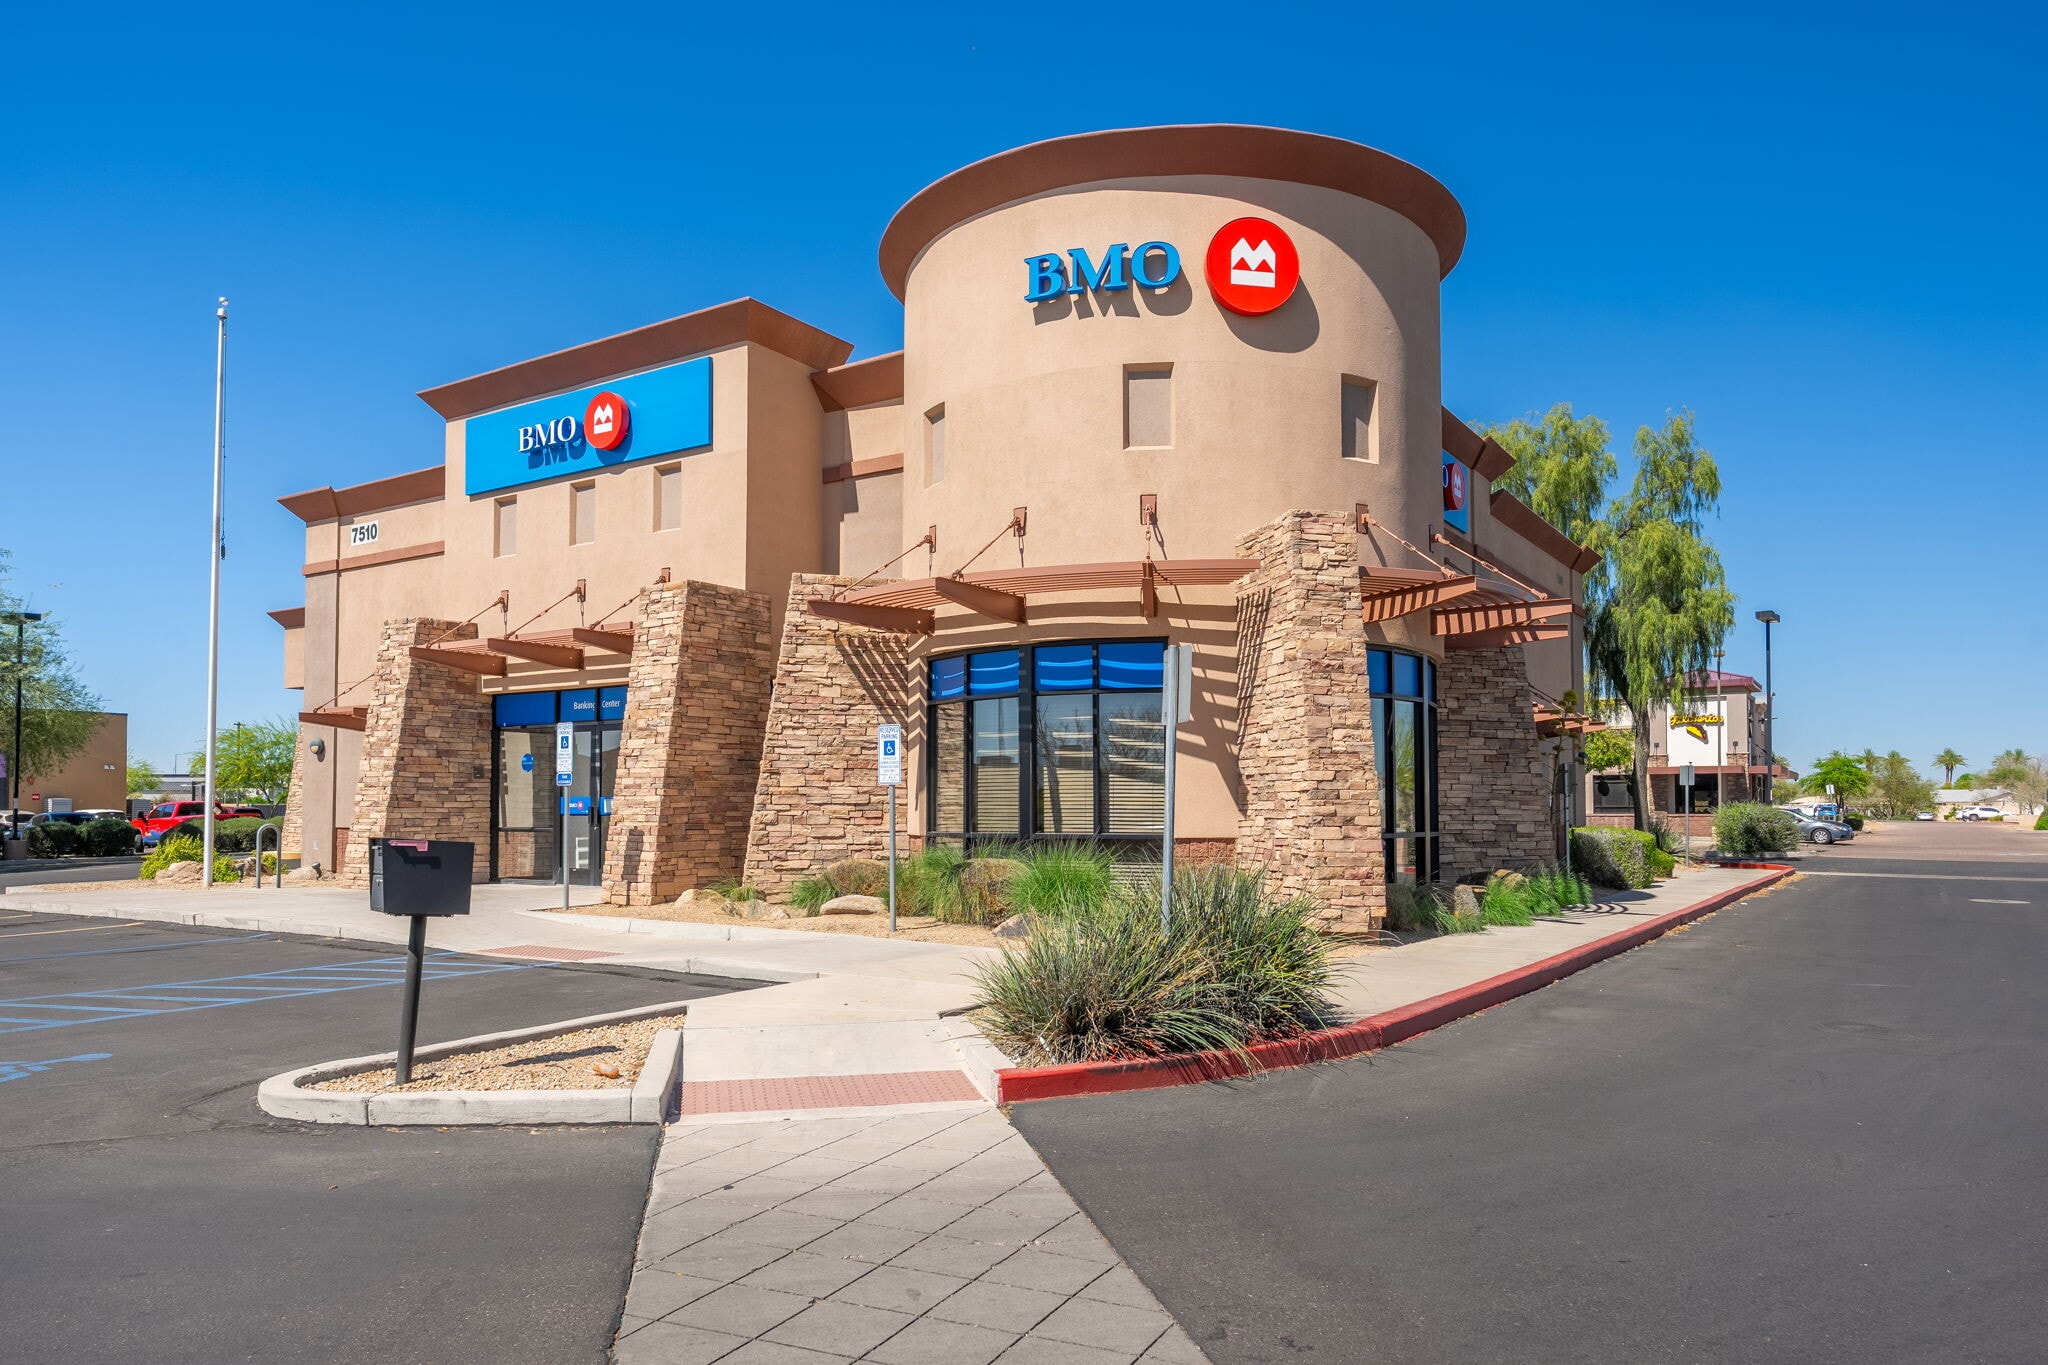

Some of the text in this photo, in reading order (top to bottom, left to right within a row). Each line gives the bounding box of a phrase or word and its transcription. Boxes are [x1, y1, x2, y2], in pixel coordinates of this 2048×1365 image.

[1024, 241, 1181, 303] BMO
[517, 415, 577, 453] BMO
[352, 523, 378, 543] 7510
[601, 700, 621, 709] Center
